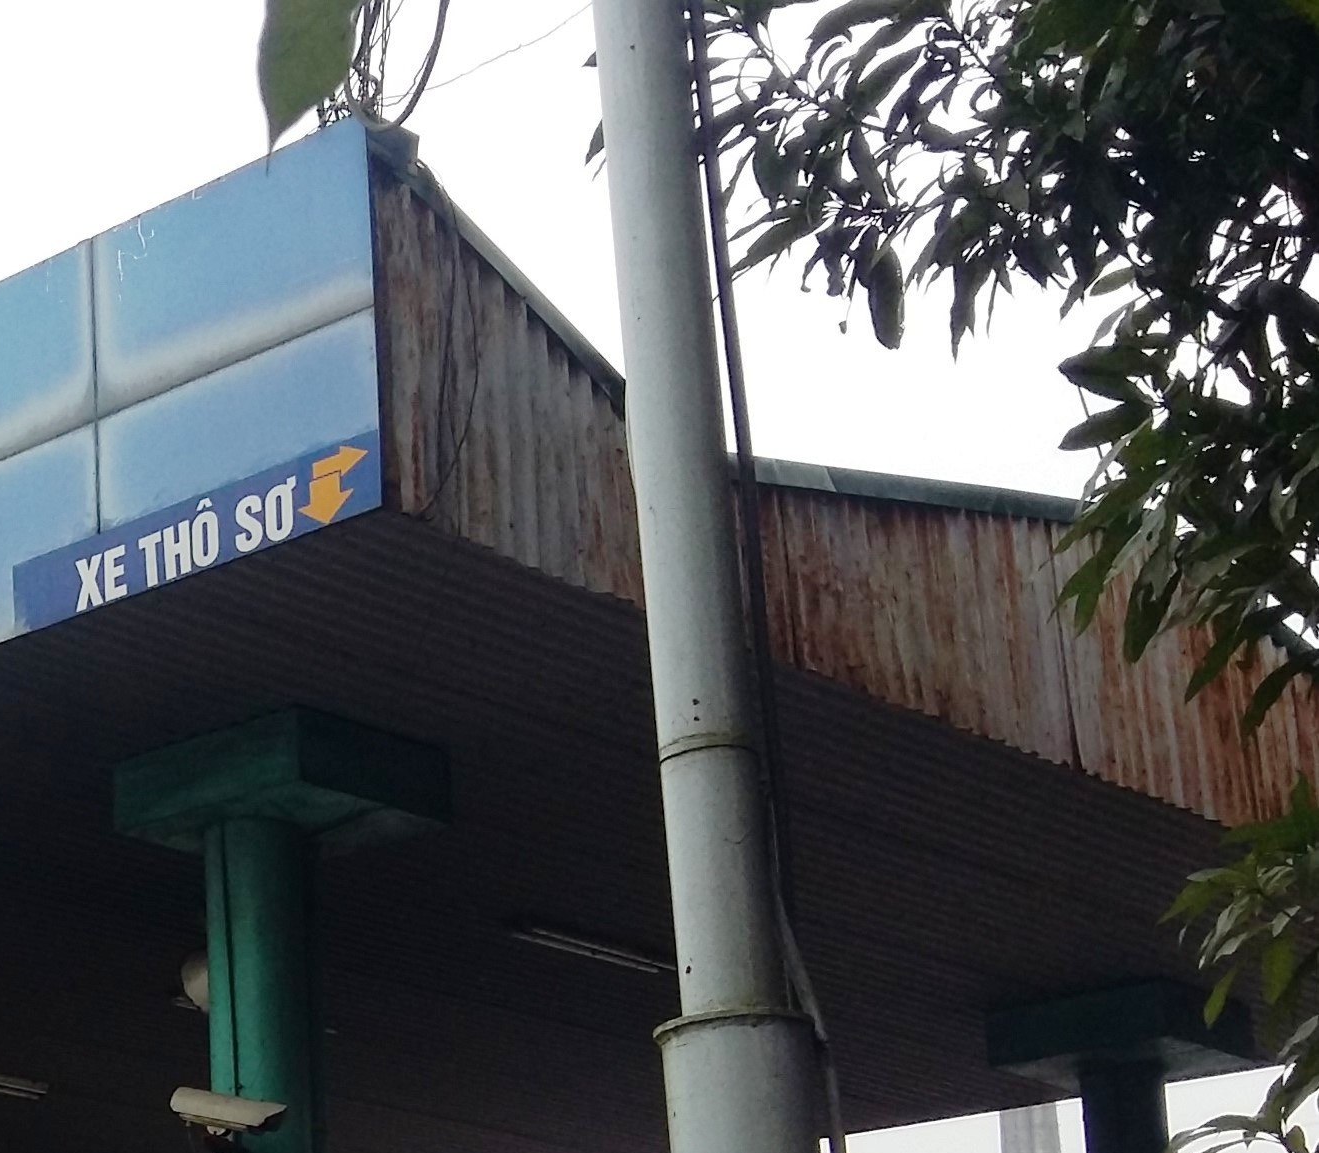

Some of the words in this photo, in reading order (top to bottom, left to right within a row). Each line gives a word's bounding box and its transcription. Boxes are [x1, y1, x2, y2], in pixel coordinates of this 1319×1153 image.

[75, 545, 128, 613] XE
[138, 499, 220, 589] THÔ
[235, 475, 296, 552] SƠ
